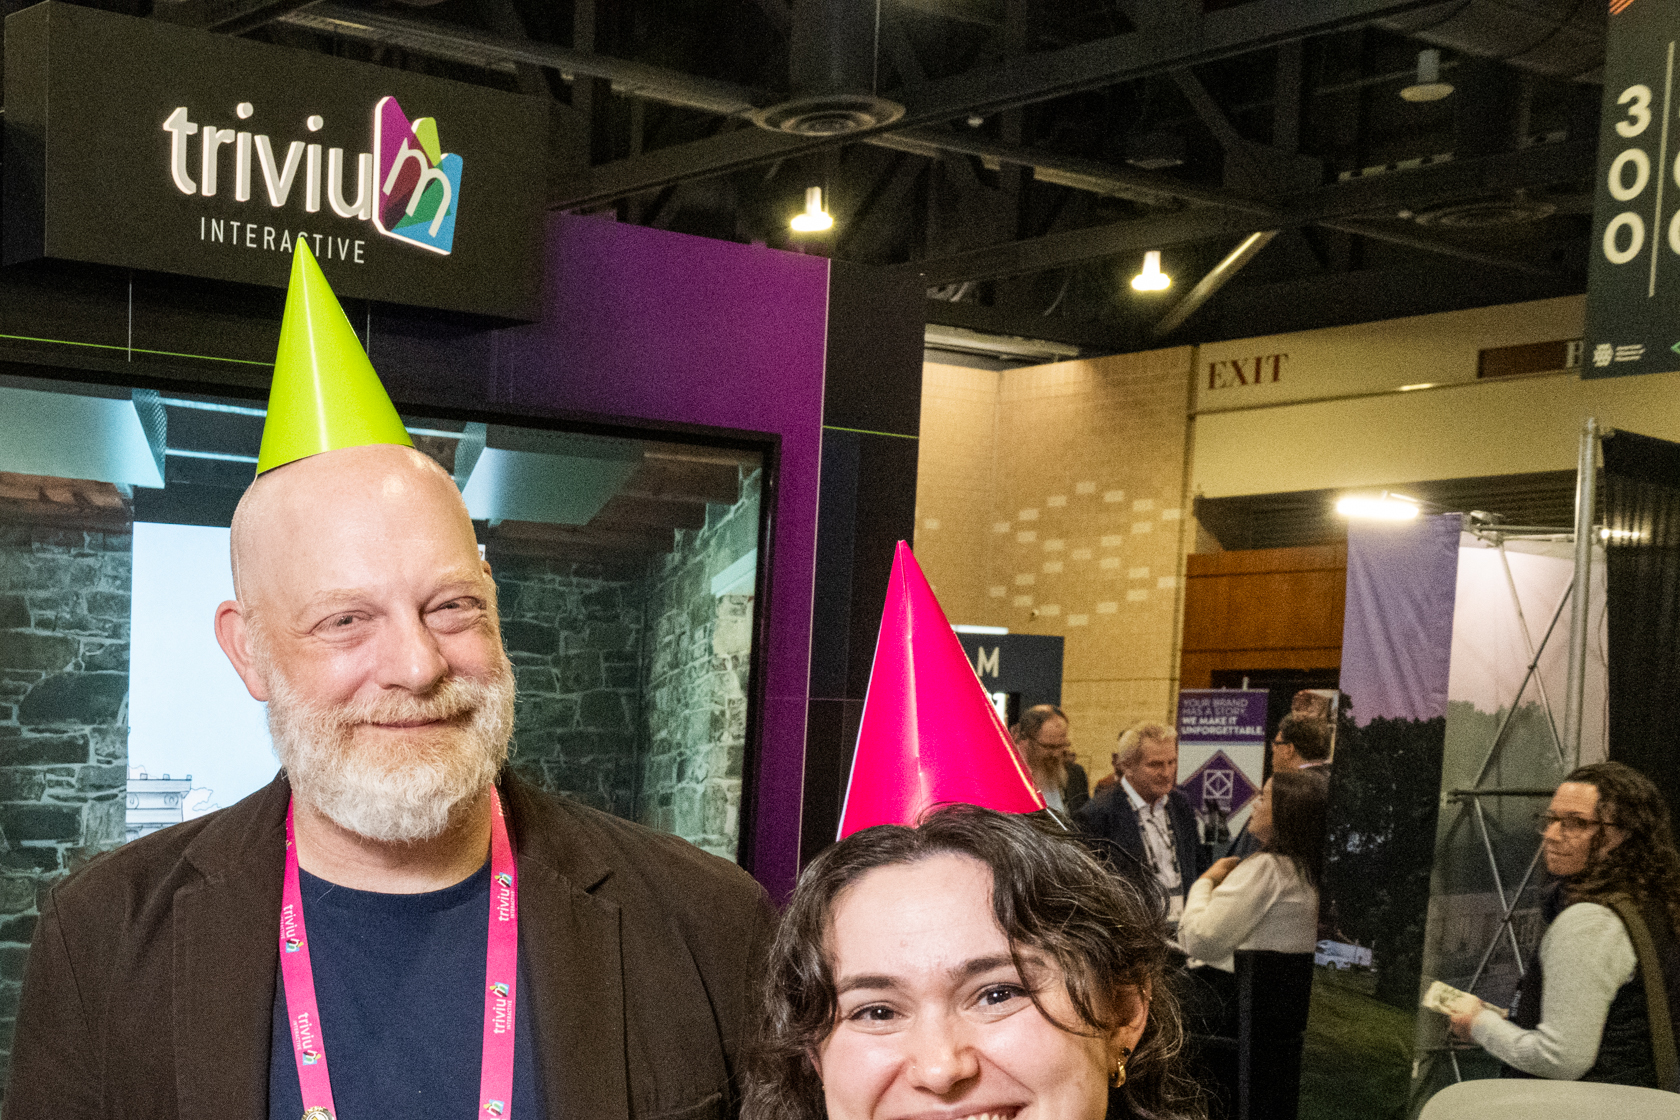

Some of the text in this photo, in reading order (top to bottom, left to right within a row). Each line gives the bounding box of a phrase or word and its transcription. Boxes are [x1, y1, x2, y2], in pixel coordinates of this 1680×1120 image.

[162, 102, 452, 238] trivium
[200, 217, 365, 263] INTERATIVE
[1207, 353, 1289, 390] EXIT
[1182, 717, 1238, 725] WE MAKE IT
[1183, 699, 1248, 707] YOUR BRAND
[497, 874, 512, 921] trivium
[283, 904, 300, 951] trivium
[492, 983, 509, 1034] trivium
[297, 1012, 318, 1065] trivium
